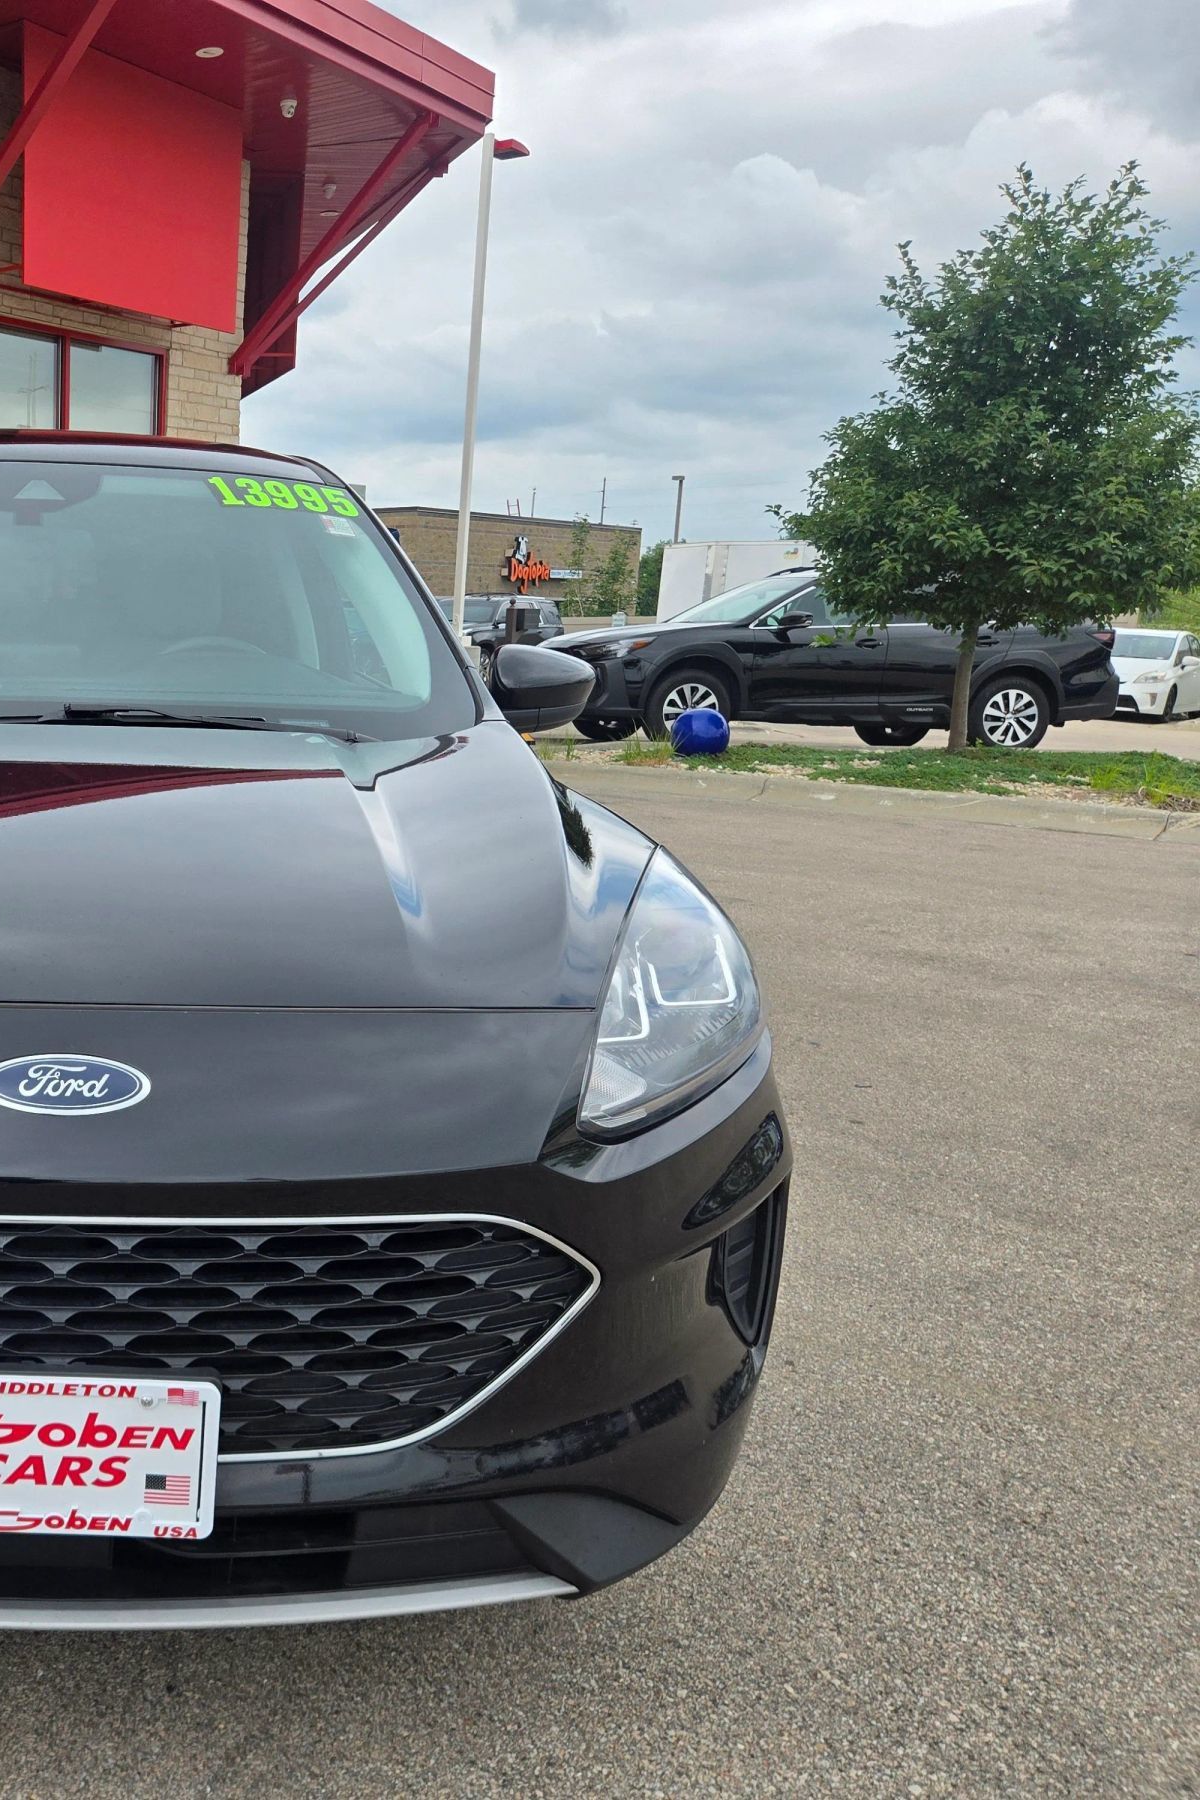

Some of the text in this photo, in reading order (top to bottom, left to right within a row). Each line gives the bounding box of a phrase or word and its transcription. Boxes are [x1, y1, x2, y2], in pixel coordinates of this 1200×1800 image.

[207, 476, 359, 517] 13995
[511, 551, 549, 594] Dogtopia
[18, 1064, 111, 1098] Ford
[153, 1525, 199, 1539] USA
